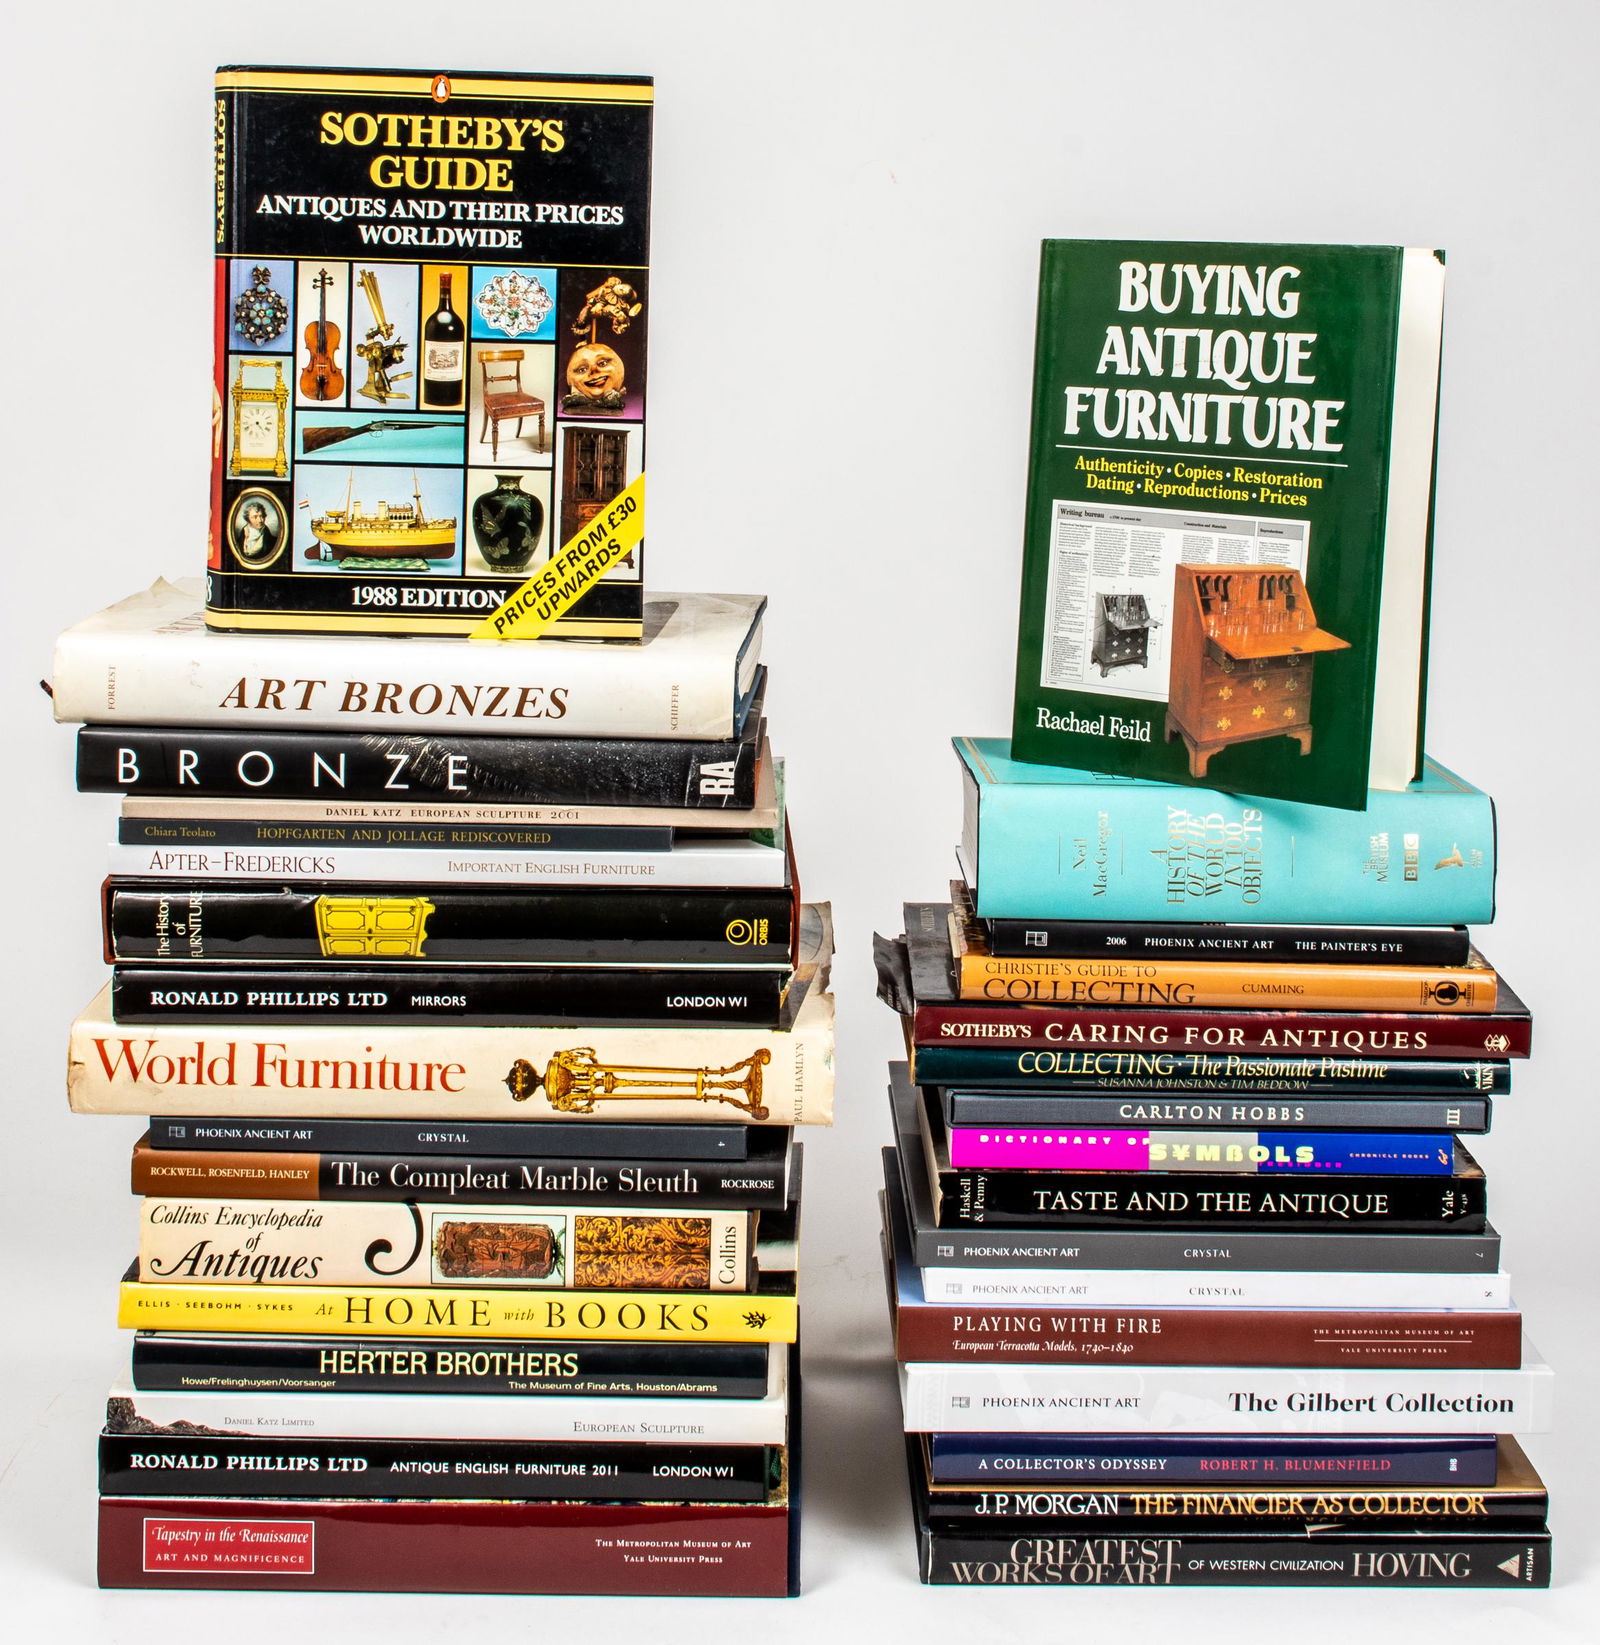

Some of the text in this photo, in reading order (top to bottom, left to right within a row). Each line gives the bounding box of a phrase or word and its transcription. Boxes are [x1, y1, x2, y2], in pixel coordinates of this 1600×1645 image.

[320, 110, 565, 153] SOTHEBY'S
[370, 155, 514, 192] GUIDE
[256, 195, 624, 226] ANTIQUES AND THEIR PRICES
[359, 225, 522, 249] WORLDWIDE
[1117, 260, 1302, 319] BUYING
[1096, 325, 1317, 391] ANTIQUE
[1063, 386, 1346, 453] FURNITURE
[1074, 455, 1323, 490] Authenticity Copies Restoration
[1086, 474, 1308, 507] Dating Reproductions Prices
[494, 496, 637, 634] PRICES FROM £30
[538, 538, 621, 622] UPWARDS
[352, 585, 506, 608] 1988 EDITION
[107, 664, 116, 710] FORREST
[219, 677, 569, 719] ART BRONZES
[670, 684, 680, 731] SCHIFFER
[1036, 707, 1151, 742] Rachael Feild
[118, 747, 468, 791] BRONZE
[700, 760, 735, 795] RA
[326, 808, 367, 817] DANIEL
[372, 808, 402, 817] KATZ
[411, 809, 470, 819] EUROPEAN
[476, 809, 542, 820] SCULPTURE
[144, 826, 551, 844] Chiara Teolato HOPFGARTEN AND JOLLAGE REDISCOVERED
[1072, 838, 1087, 870] Neil
[1092, 810, 1111, 897] MacGregor
[1167, 804, 1187, 903] HISTORY
[1205, 813, 1224, 897] WORLD
[1242, 808, 1263, 905] OBJECTS
[1404, 834, 1419, 881] BBC
[759, 919, 768, 946] ORBIS
[984, 961, 1157, 977] CHRISTIE'S GUIDE TO
[983, 978, 1304, 1004] COLLECTING CUMMING
[940, 1022, 1428, 1053] SOTHEBY'S CARING FOR ANTIQUES
[92, 1038, 466, 1093] World Furniture
[1018, 1051, 1388, 1079] COLLECTING The Passionate Pastime
[1119, 1104, 1305, 1121] CARLTON HOBBS
[195, 1128, 469, 1143] PHOENIX ANCIENT ART CRYSTAL
[980, 1135, 1111, 1145] DICTIONARY
[150, 1167, 206, 1179] ROCKWELL,
[269, 1169, 310, 1180] HANLEY
[331, 1161, 775, 1196] The Compleat Marble Sleuth ROCKROSE
[150, 1204, 323, 1229] Collins Encyclopedia
[1033, 1191, 1388, 1218] TASTE AND THE ANTIQUE
[1442, 1190, 1454, 1218] Yale
[245, 1232, 264, 1253] of
[718, 1226, 737, 1285] Collins
[150, 1239, 323, 1284] Antiques
[315, 1296, 709, 1332] At HOME with BOOKS
[953, 1316, 1162, 1334] PLAYING WITH FIRE
[1334, 1328, 1400, 1336] METROPOLITAN
[320, 1350, 579, 1377] HERTER BROTHERS
[181, 1377, 336, 1388] Howe/Frelinghuysen/Voorsanger
[509, 1381, 528, 1390] The
[530, 1382, 572, 1391] Museum
[575, 1382, 585, 1391] of
[587, 1382, 607, 1391] Fine
[636, 1382, 718, 1392] Houston/Abrams
[1229, 1392, 1515, 1414] The Gilbert Collection
[130, 1454, 734, 1478] RONALD PHILLIPS LTD ANTIQUE ENGLISH FURNITURE 2011 LONDON W1
[978, 1458, 1391, 1471] A COLLECTOR'S ODYSSEY ROBERT H. BLUMENFIELD
[975, 1493, 1489, 1516] J.P. MORGAN THE FINANCIER AS COLLECTOR
[151, 1525, 309, 1546] Tapestry in the Renaissance
[155, 1553, 305, 1564] ART AND MAGNIFICENCE
[1010, 1538, 1182, 1567] GREATEST
[1526, 1547, 1534, 1582] ARTISAN
[949, 1553, 1472, 1584] WORKS OF ART OF WESTERN CIVILIZATION HOVING
